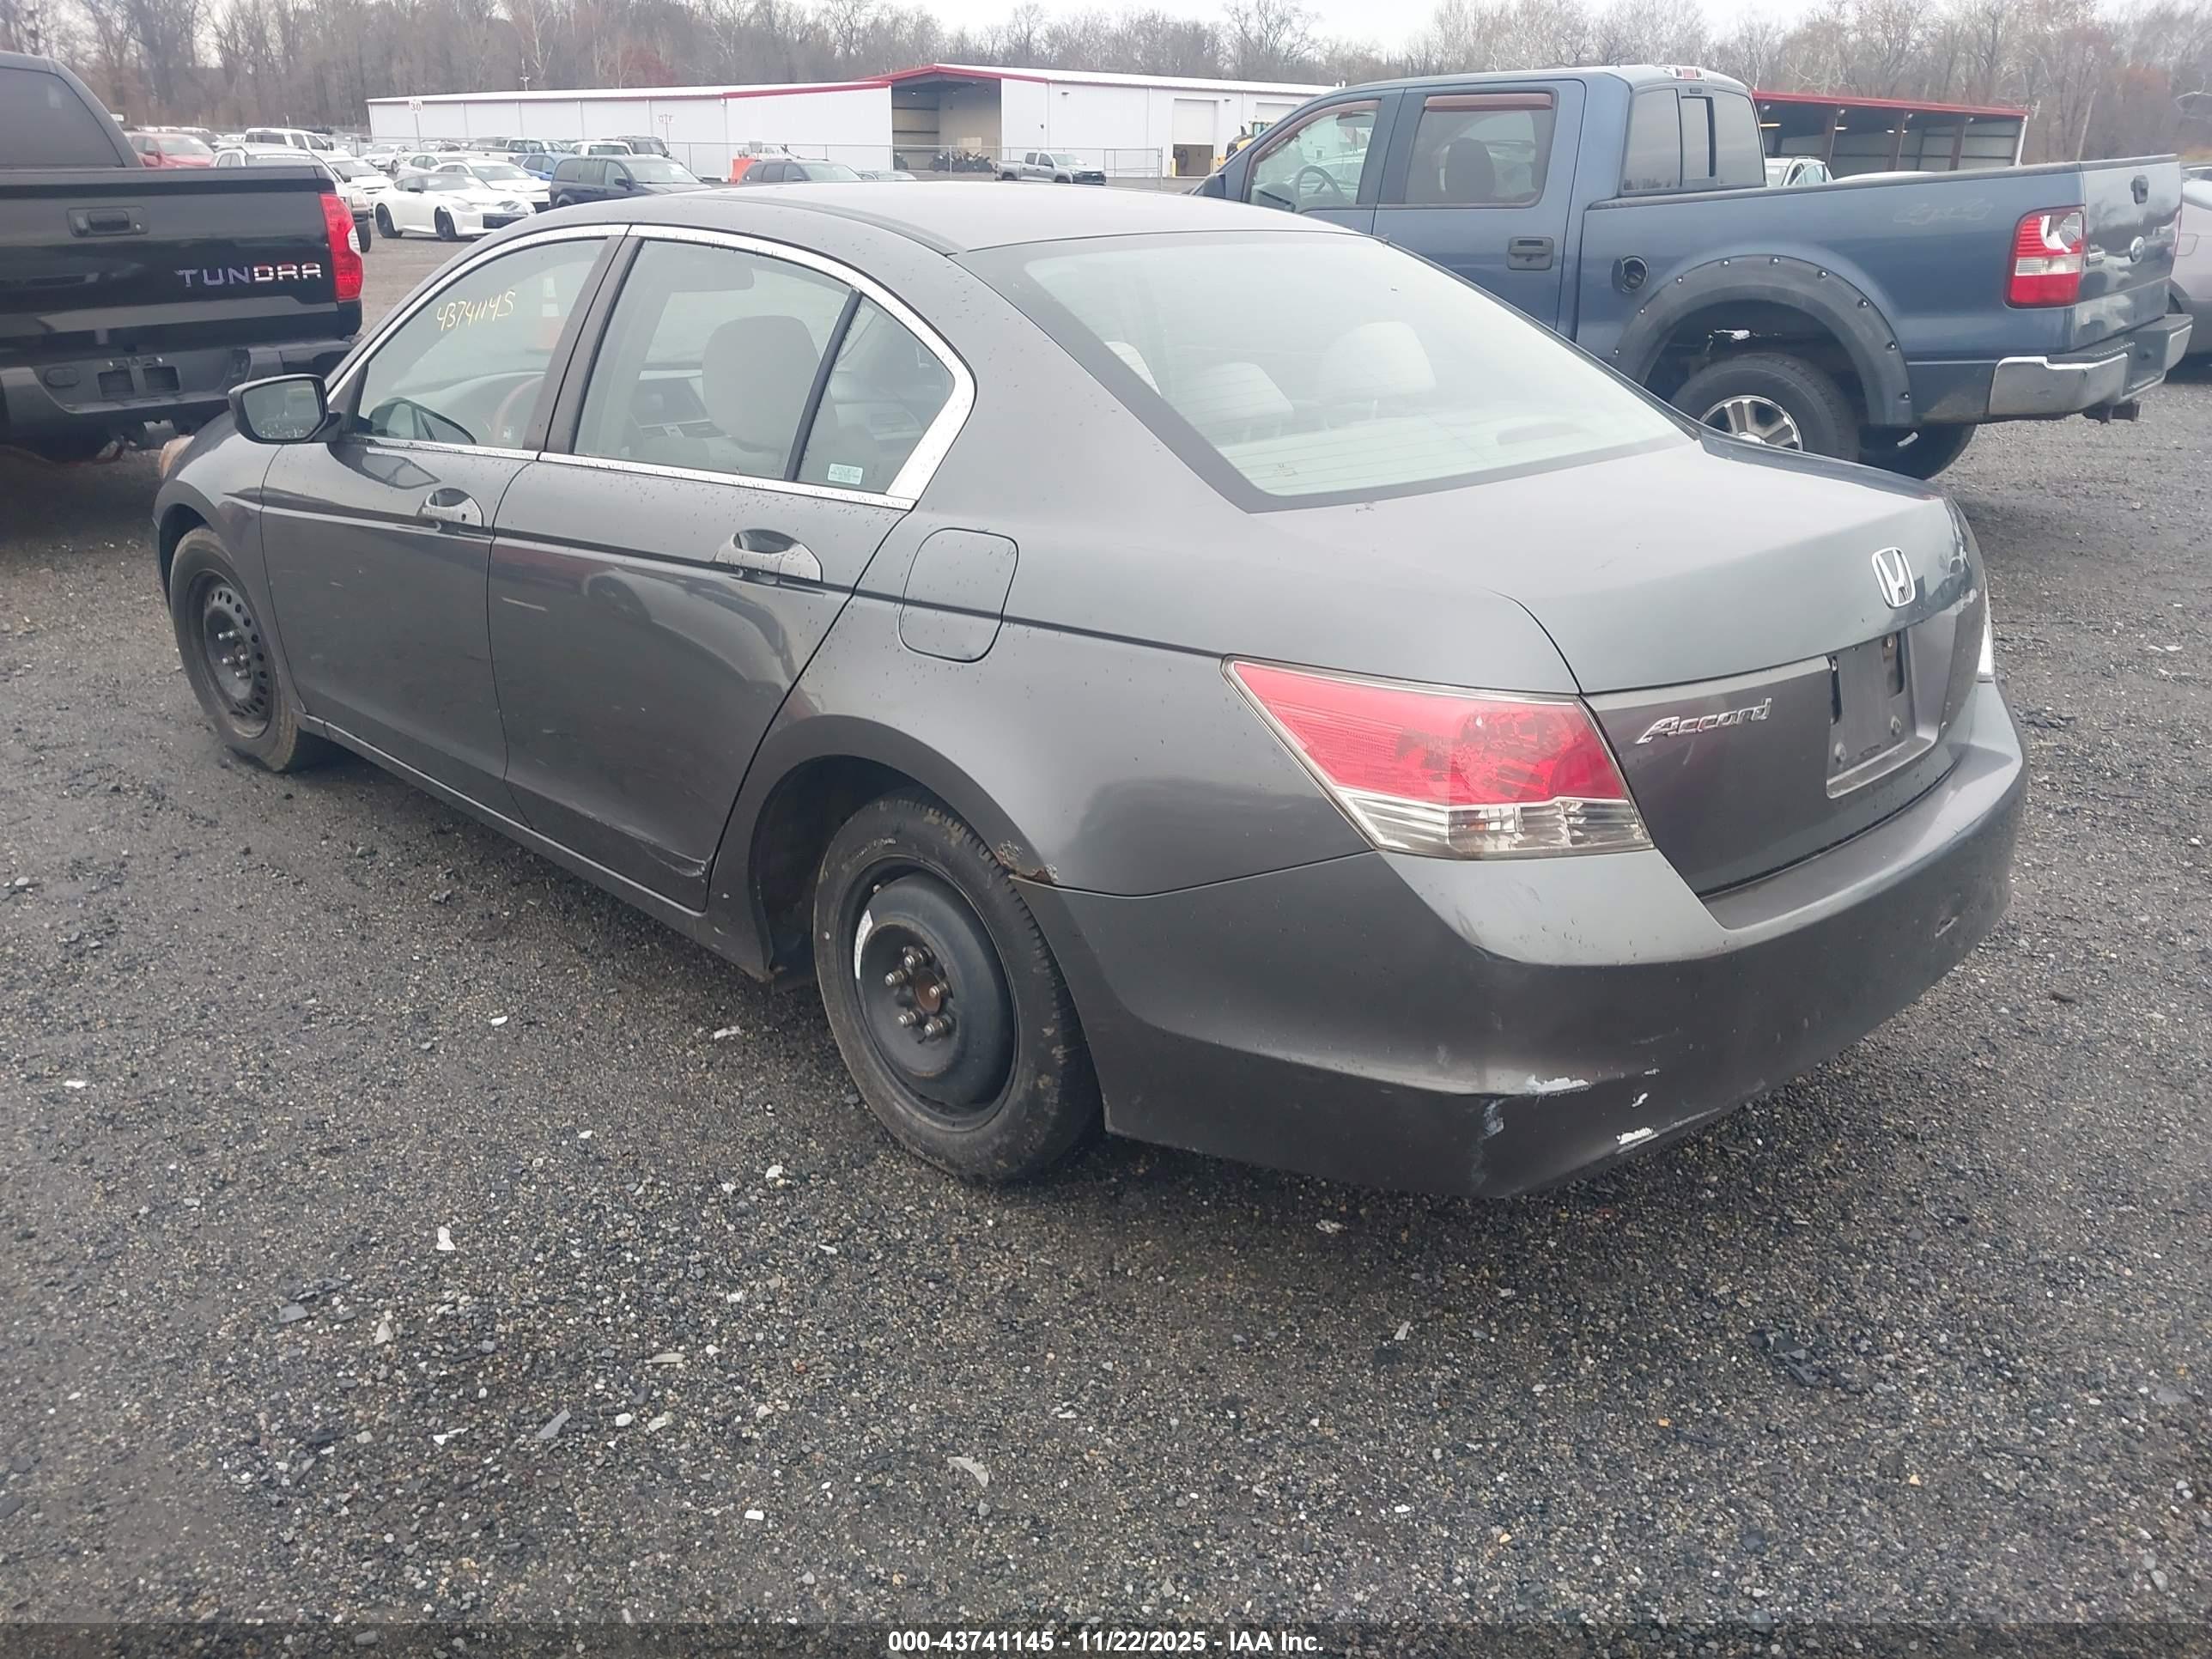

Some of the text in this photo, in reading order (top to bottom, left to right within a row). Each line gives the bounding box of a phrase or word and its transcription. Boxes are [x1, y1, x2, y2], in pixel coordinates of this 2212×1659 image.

[411, 102, 422, 112] 30
[173, 262, 323, 288] TUNDRA
[436, 289, 516, 331] 43741145
[1635, 697, 1773, 744] Accord
